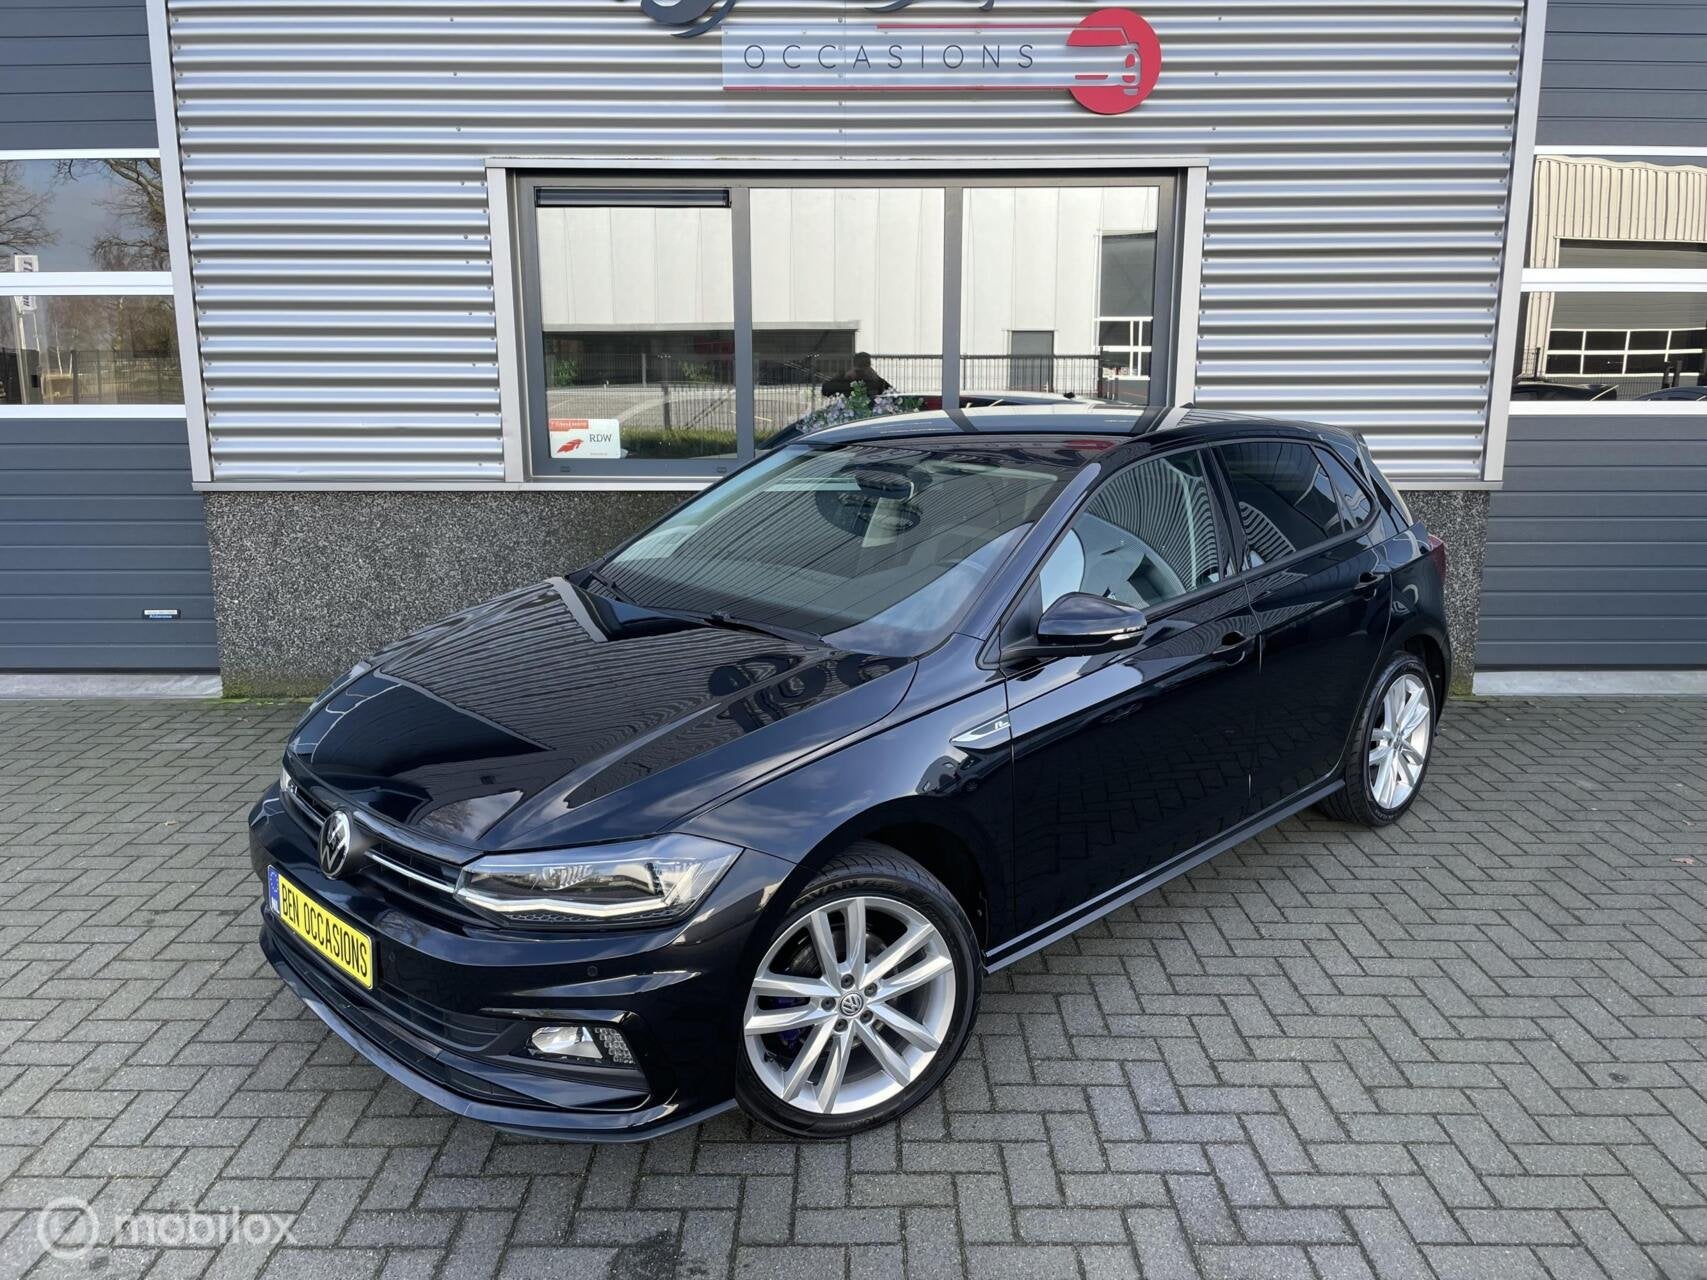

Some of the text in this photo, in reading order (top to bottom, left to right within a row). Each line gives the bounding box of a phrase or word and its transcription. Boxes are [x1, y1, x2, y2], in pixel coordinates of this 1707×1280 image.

[743, 44, 1034, 69] OCCASIONS
[589, 433, 612, 443] RDW
[281, 884, 368, 978] BEN OCCASIONS
